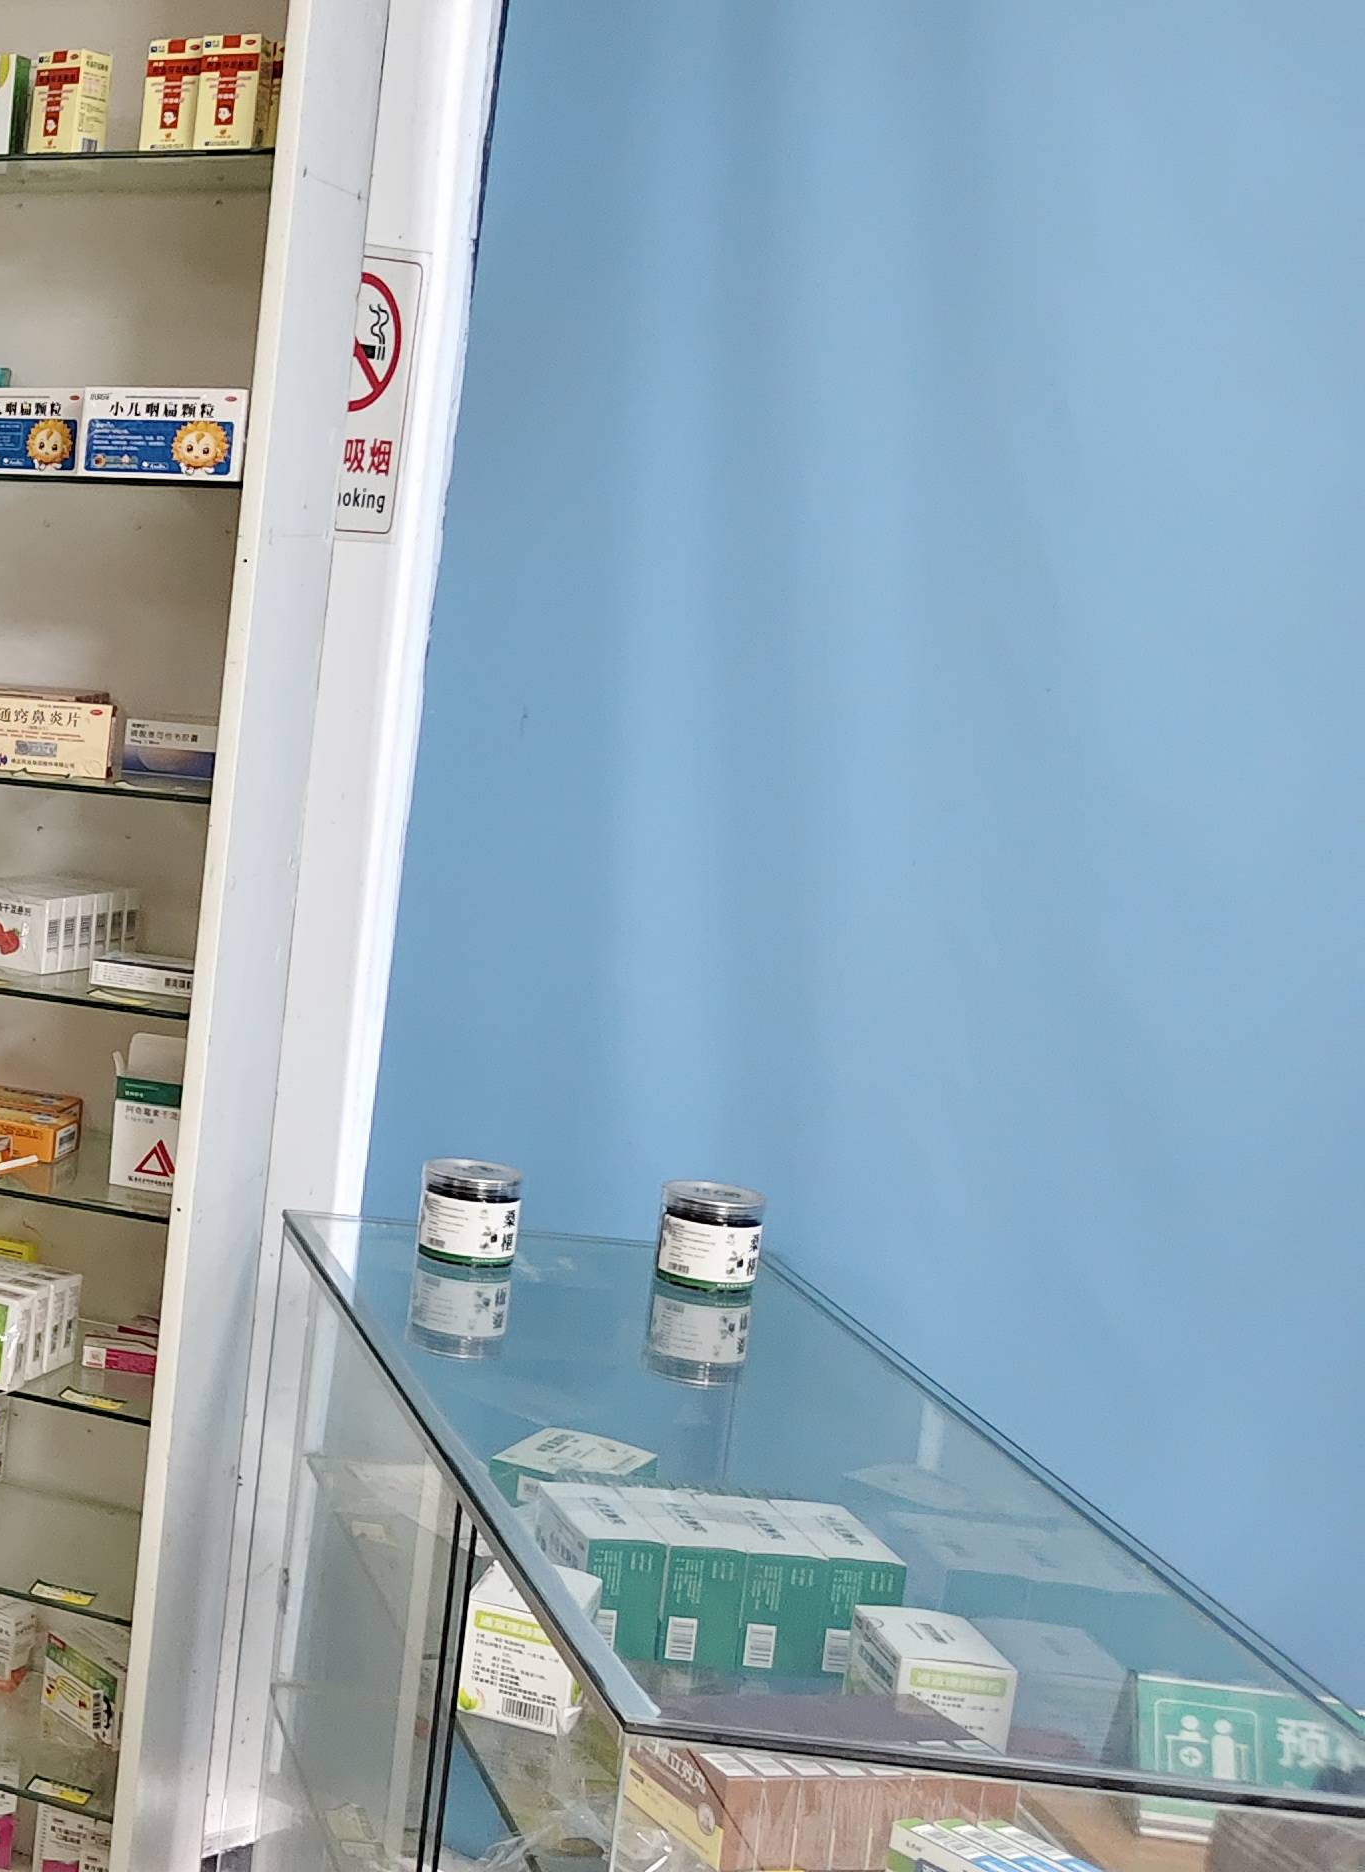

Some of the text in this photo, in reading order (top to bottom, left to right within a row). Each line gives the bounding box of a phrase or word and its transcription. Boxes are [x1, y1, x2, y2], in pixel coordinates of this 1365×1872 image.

[109, 402, 215, 418] 小儿咽扁颗粒
[343, 438, 393, 477] 吸烟
